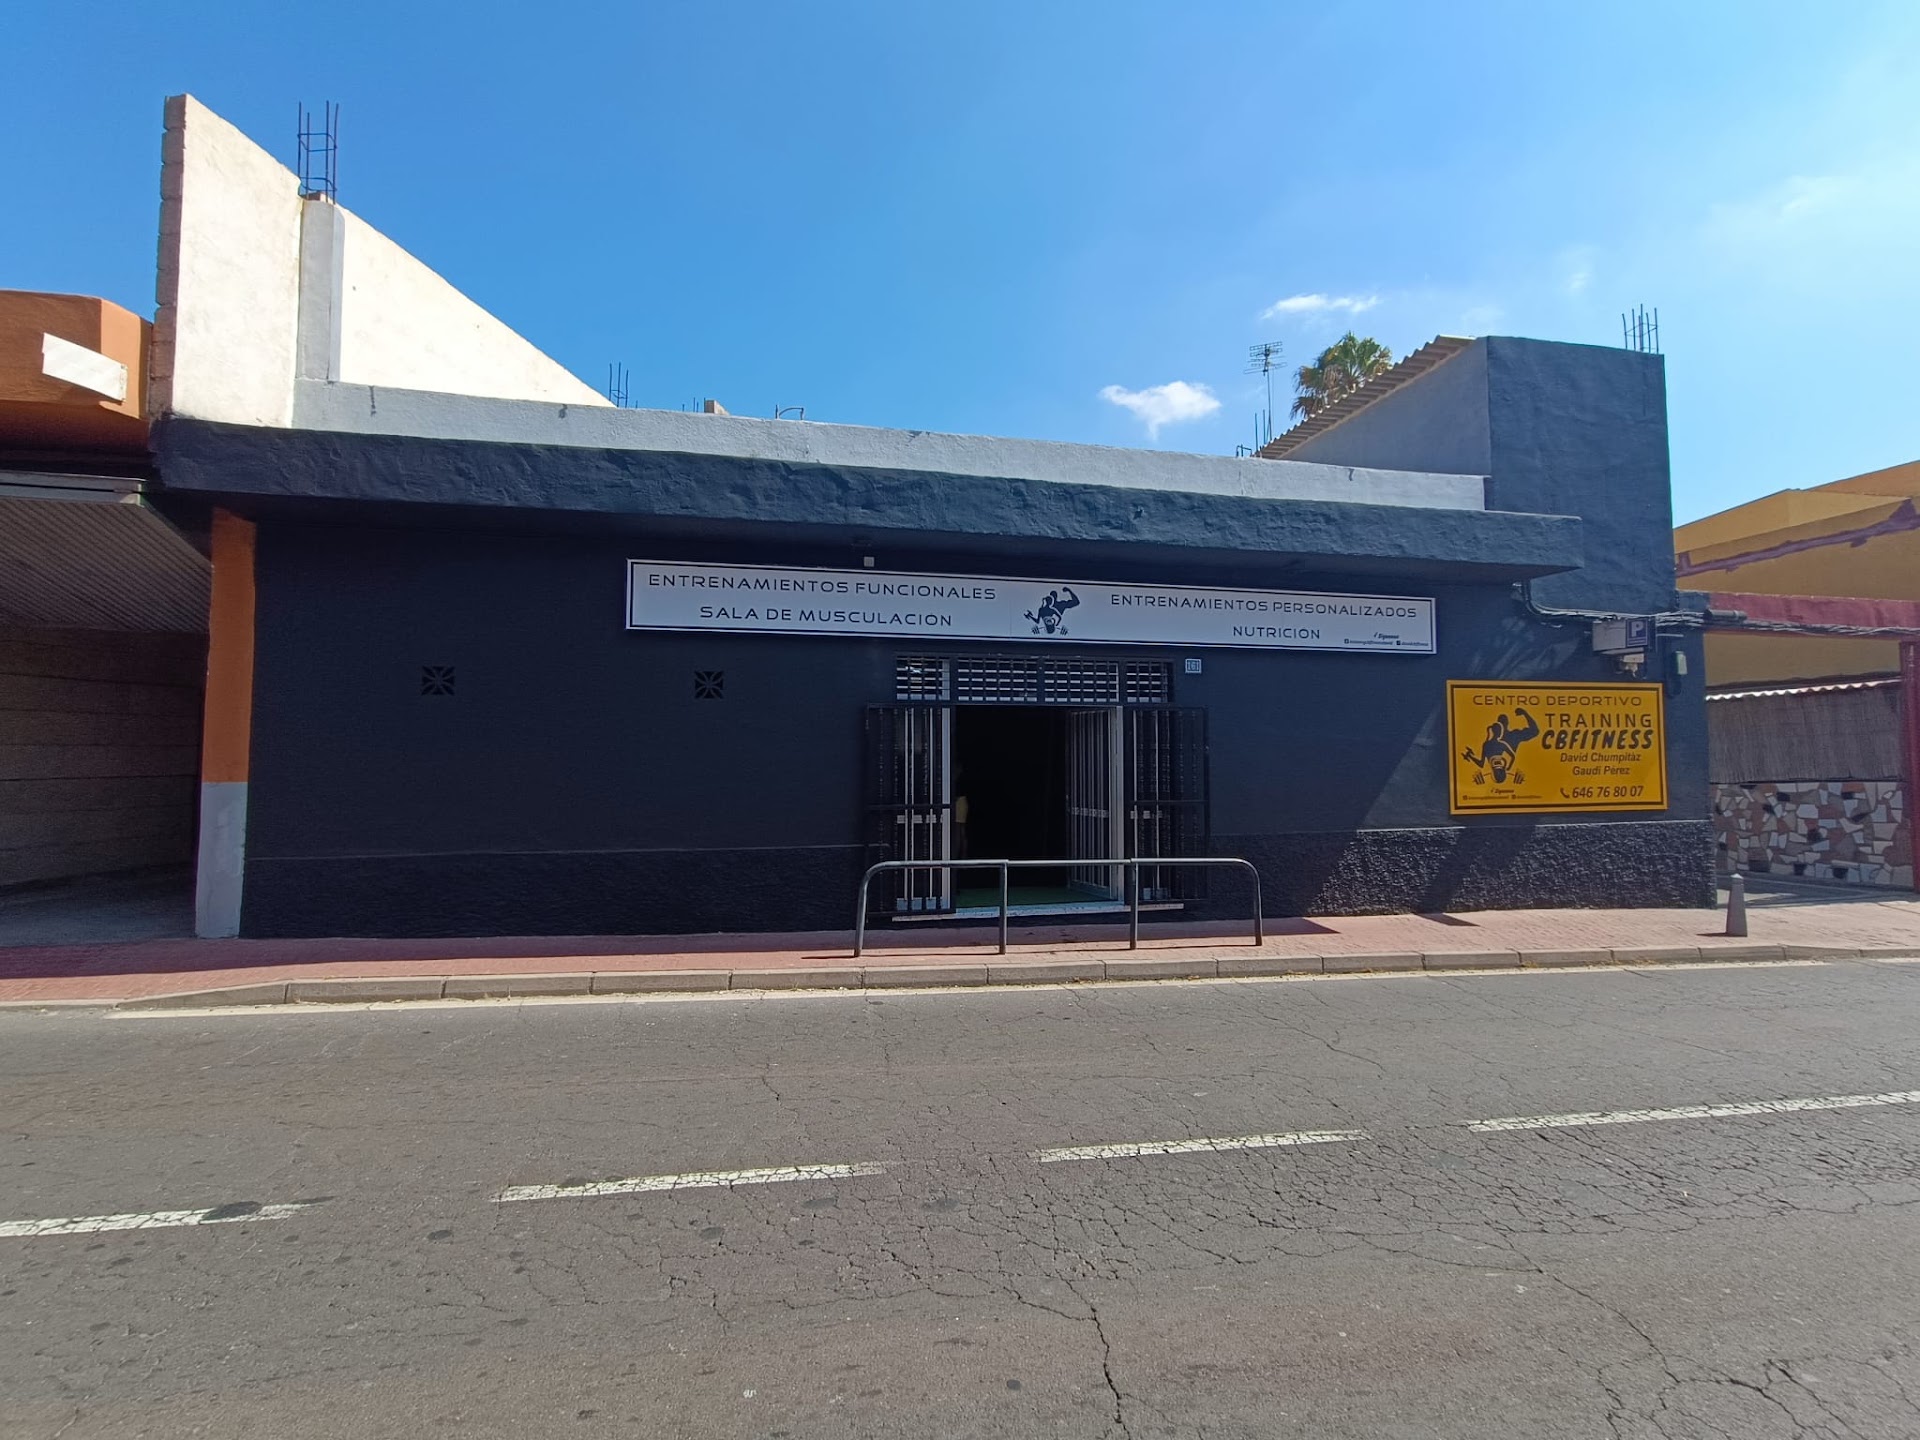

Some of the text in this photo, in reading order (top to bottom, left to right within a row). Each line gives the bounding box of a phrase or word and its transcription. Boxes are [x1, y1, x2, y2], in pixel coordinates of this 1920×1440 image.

[649, 574, 997, 600] ENTRENAMIENTOS FUNCIONALES
[700, 606, 759, 620] SALA
[766, 608, 792, 621] DE
[1111, 594, 1418, 618] ENTRENAMIENTOS PERSONALIZADOS
[1631, 621, 1644, 637] P
[1473, 695, 1642, 707] CENTRO DEPORTIVO
[1545, 713, 1652, 728] TRAINING
[1541, 729, 1654, 750] CBFITNESS
[1560, 752, 1588, 763] David
[1572, 785, 1644, 799] 646 76 80 07
